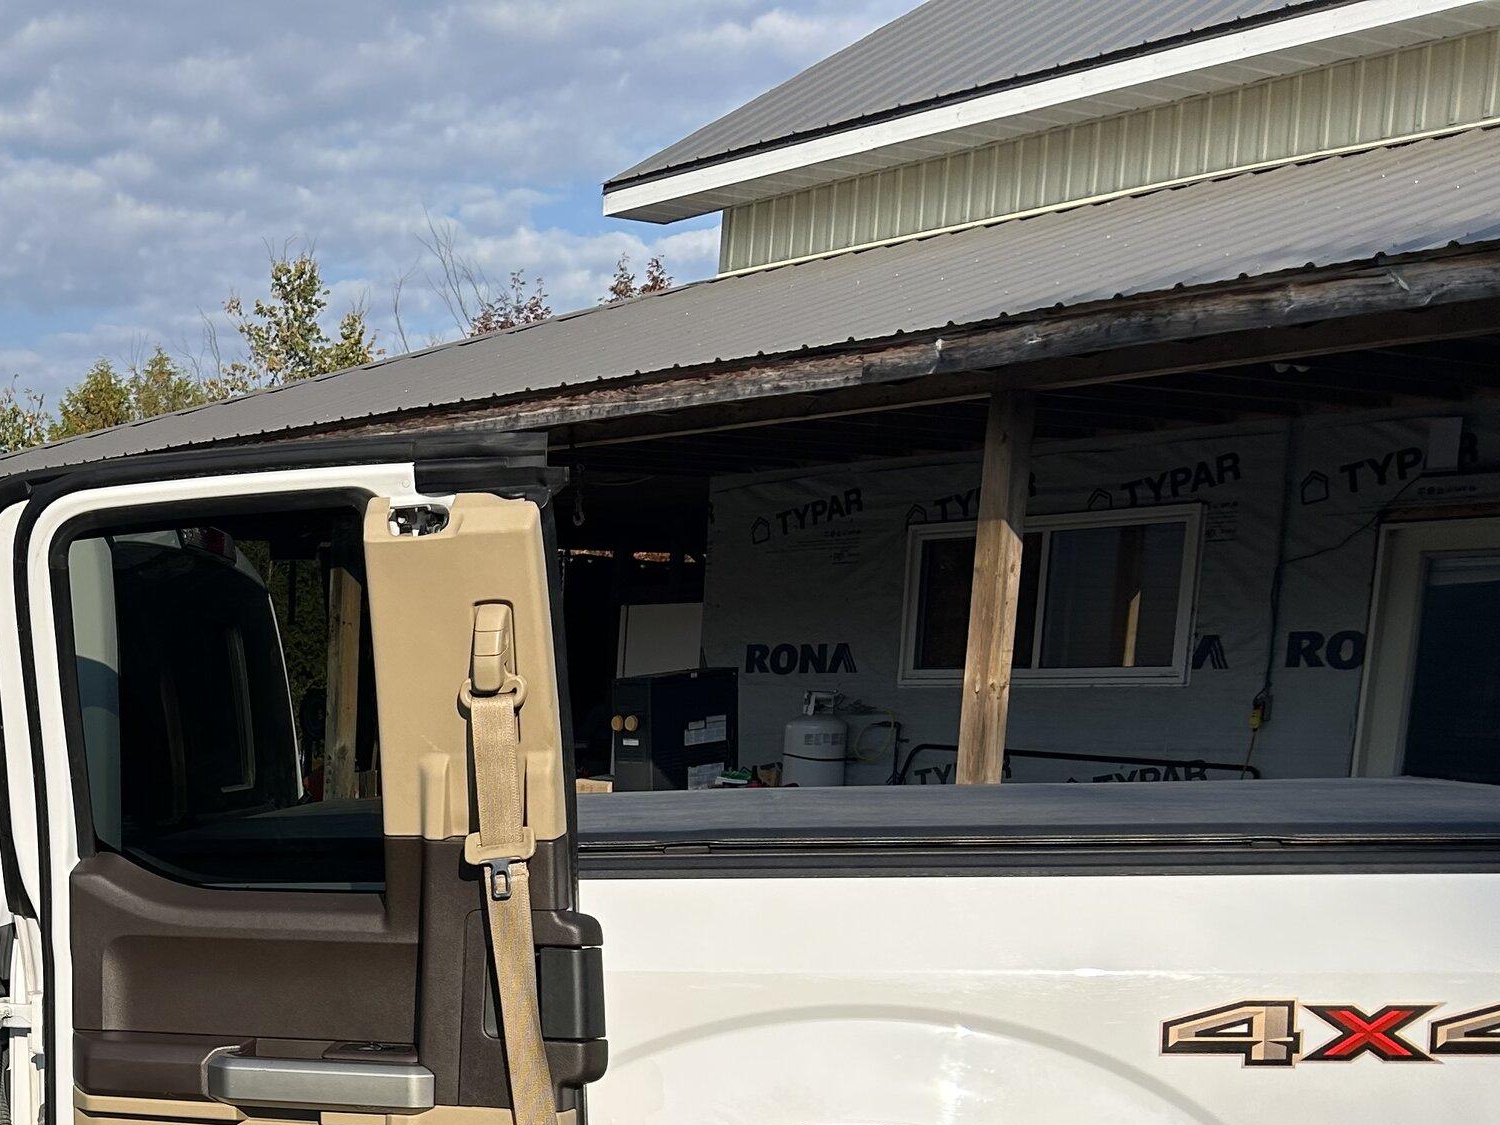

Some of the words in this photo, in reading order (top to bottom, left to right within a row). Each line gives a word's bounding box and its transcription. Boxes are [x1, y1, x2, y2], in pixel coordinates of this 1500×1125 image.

[1121, 452, 1242, 505] TYPAR
[776, 488, 864, 536] TYPAR
[745, 643, 859, 675] RONA
[1285, 630, 1367, 670] RO
